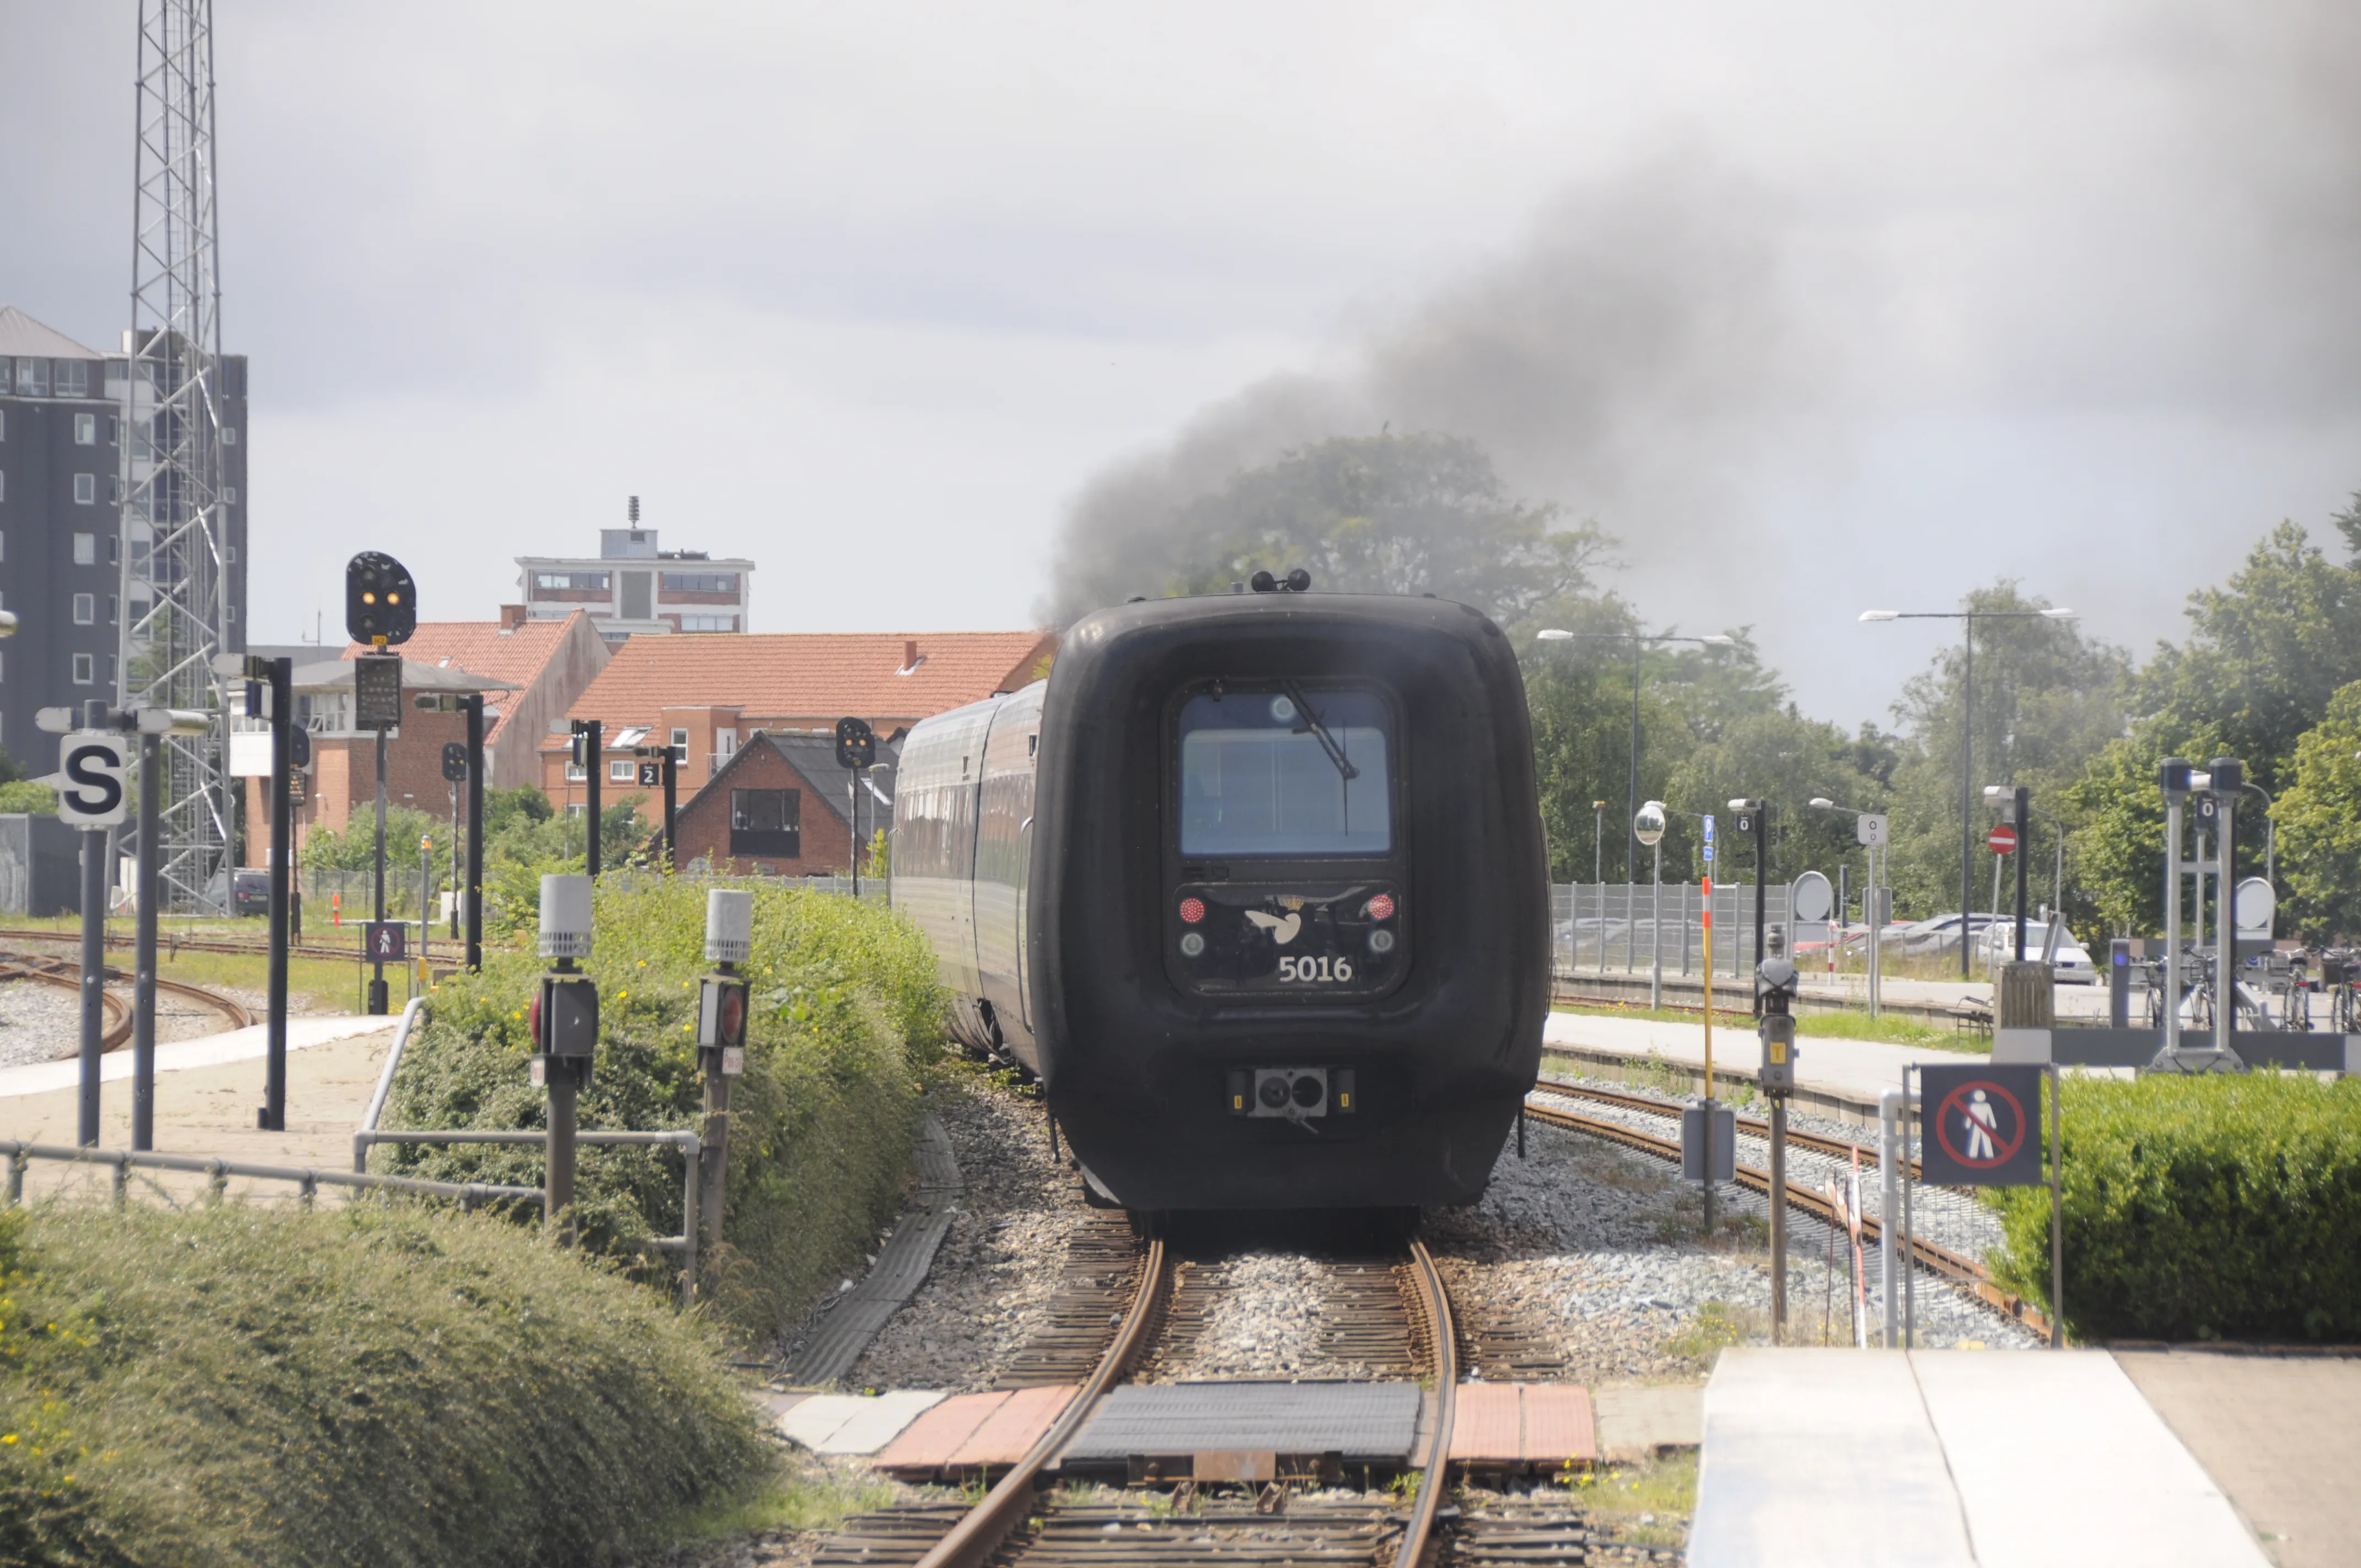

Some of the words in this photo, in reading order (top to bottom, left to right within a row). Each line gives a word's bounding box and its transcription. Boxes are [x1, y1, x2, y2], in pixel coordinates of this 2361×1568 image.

[63, 745, 122, 815] S
[644, 770, 654, 783] 2
[2202, 802, 2213, 816] 0
[1706, 818, 1712, 839] P
[1740, 820, 1748, 830] 0
[1280, 956, 1352, 982] 5016
